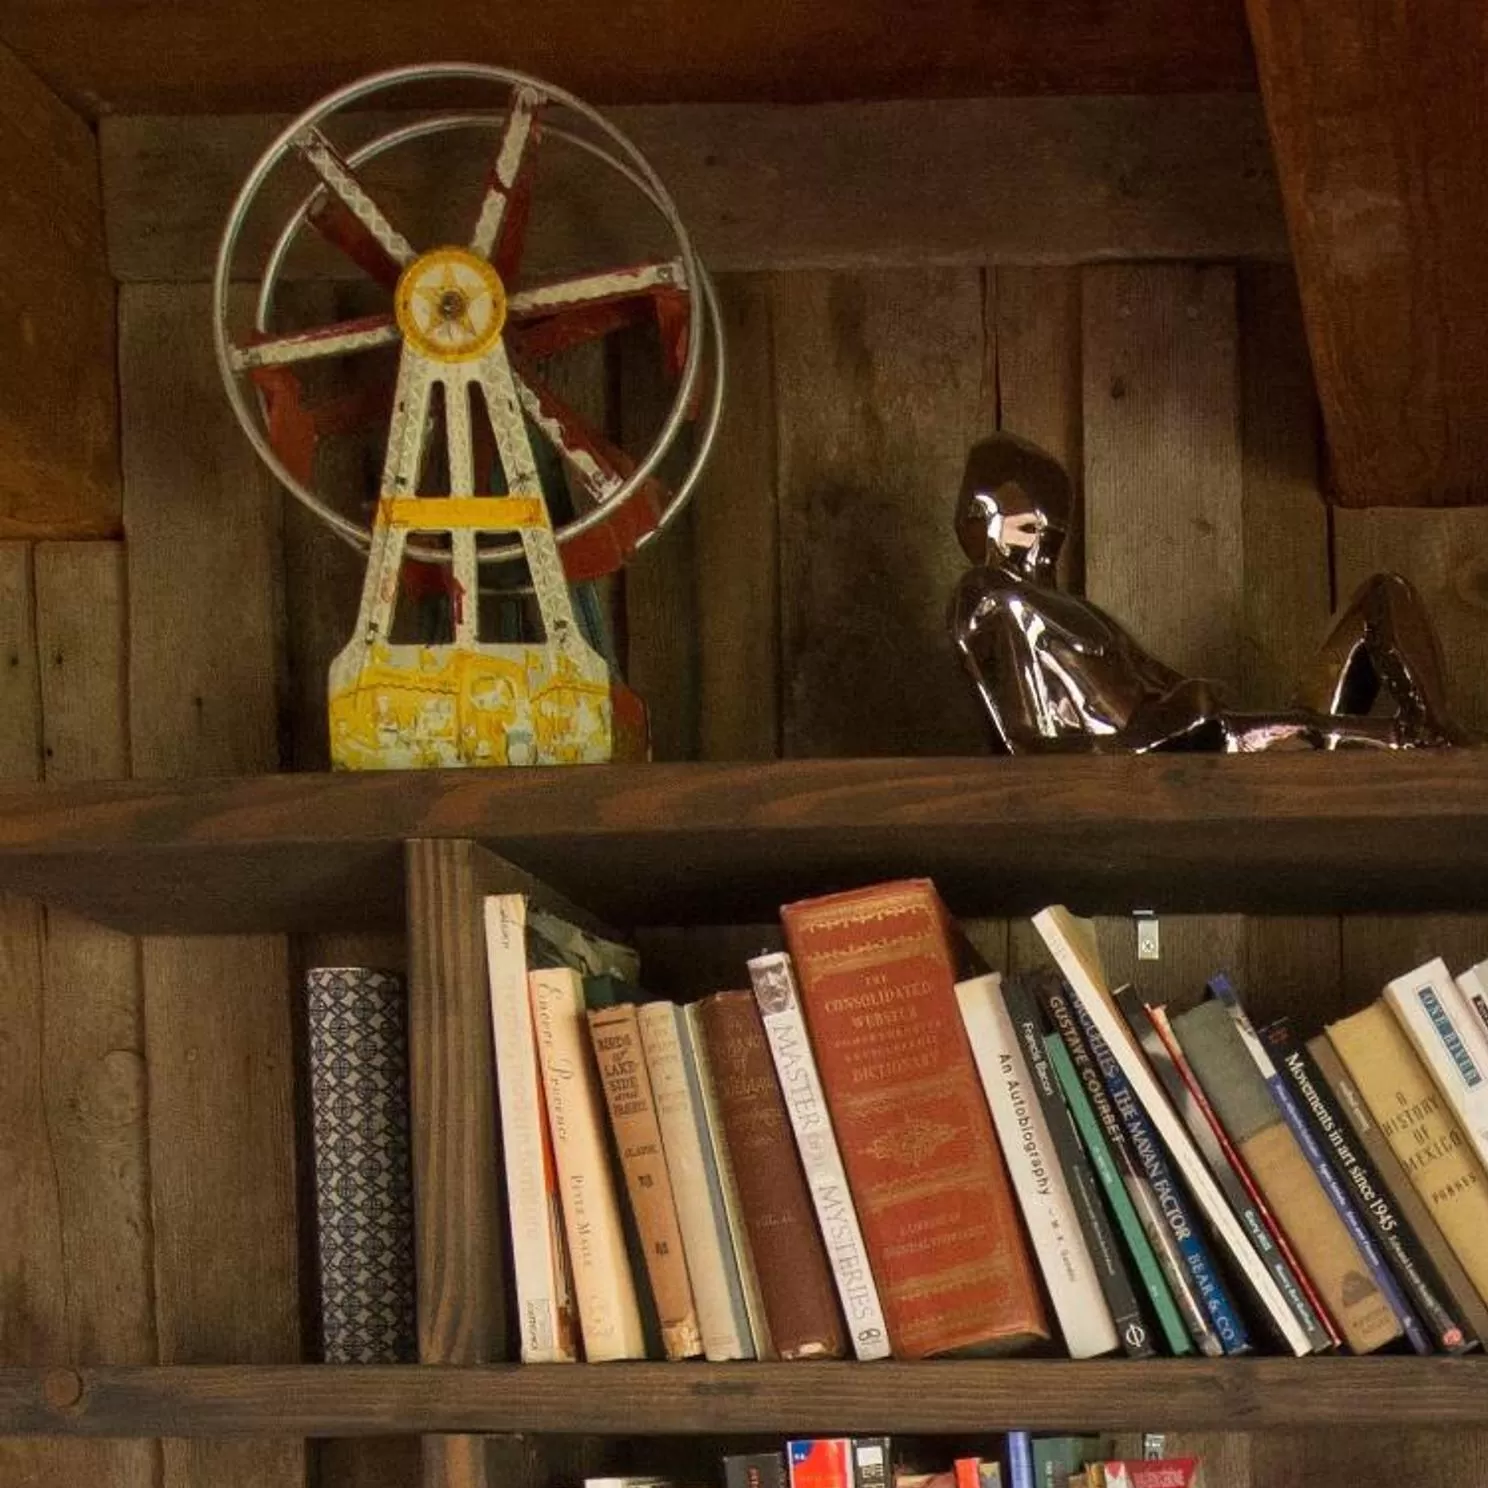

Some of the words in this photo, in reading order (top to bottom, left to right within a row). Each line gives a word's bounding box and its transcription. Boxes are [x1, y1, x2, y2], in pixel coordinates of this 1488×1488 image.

[774, 1023, 820, 1131] MASTER
[1047, 992, 1091, 1066] GUSTAVE
[1079, 1066, 1125, 1146] COURBET
[1110, 1086, 1140, 1123] THE
[1284, 1050, 1335, 1142] Movements
[1381, 1095, 1443, 1138] HISTORY
[998, 1053, 1013, 1075] An
[1006, 1081, 1051, 1197] Autobiography
[1327, 1127, 1348, 1147] in
[1124, 1117, 1166, 1182] MAYAN
[1335, 1142, 1358, 1168] art
[1400, 1131, 1463, 1173] MEXICO
[1347, 1161, 1379, 1202] since
[1152, 1177, 1192, 1242] FACTOR
[1366, 1196, 1397, 1233] 1945
[819, 1184, 874, 1322] MYSTERIES
[1185, 1251, 1216, 1299] BEAR
[1212, 1312, 1235, 1342] CO
